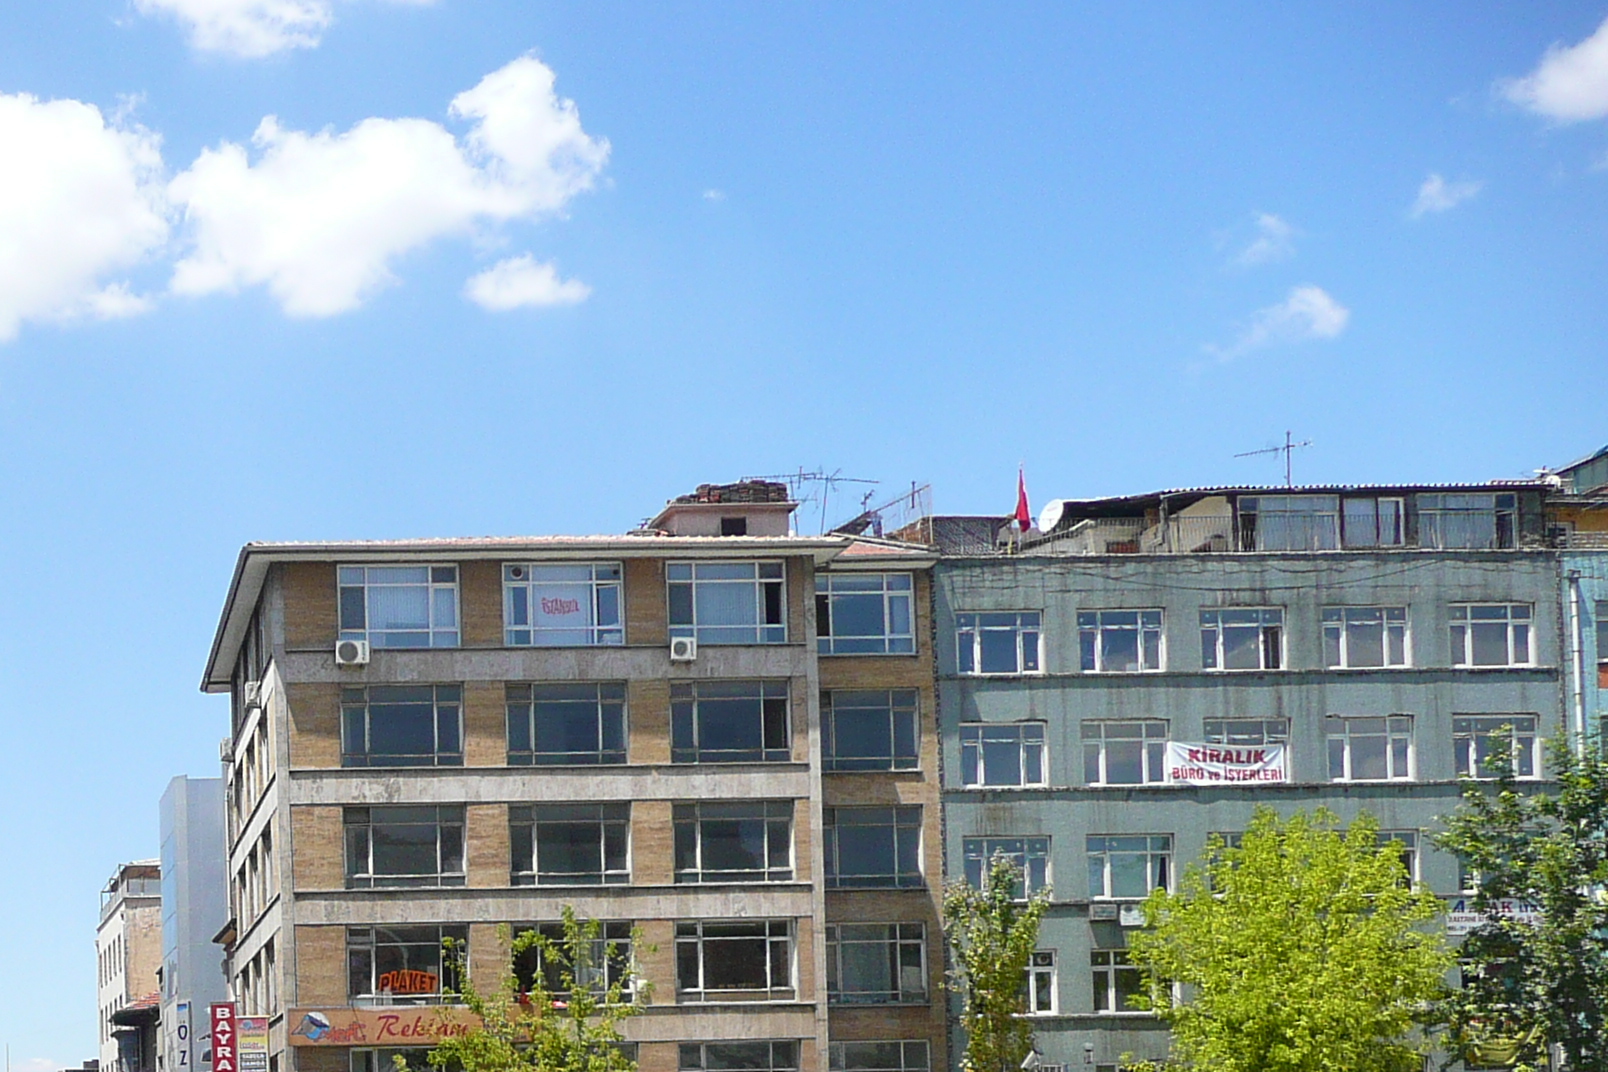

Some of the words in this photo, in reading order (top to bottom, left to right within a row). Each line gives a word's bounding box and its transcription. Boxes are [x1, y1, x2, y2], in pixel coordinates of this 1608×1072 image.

[1188, 745, 1268, 764] KİRALIK
[1223, 765, 1283, 782] İŞYERLERİ
[380, 974, 436, 992] PLAKET
